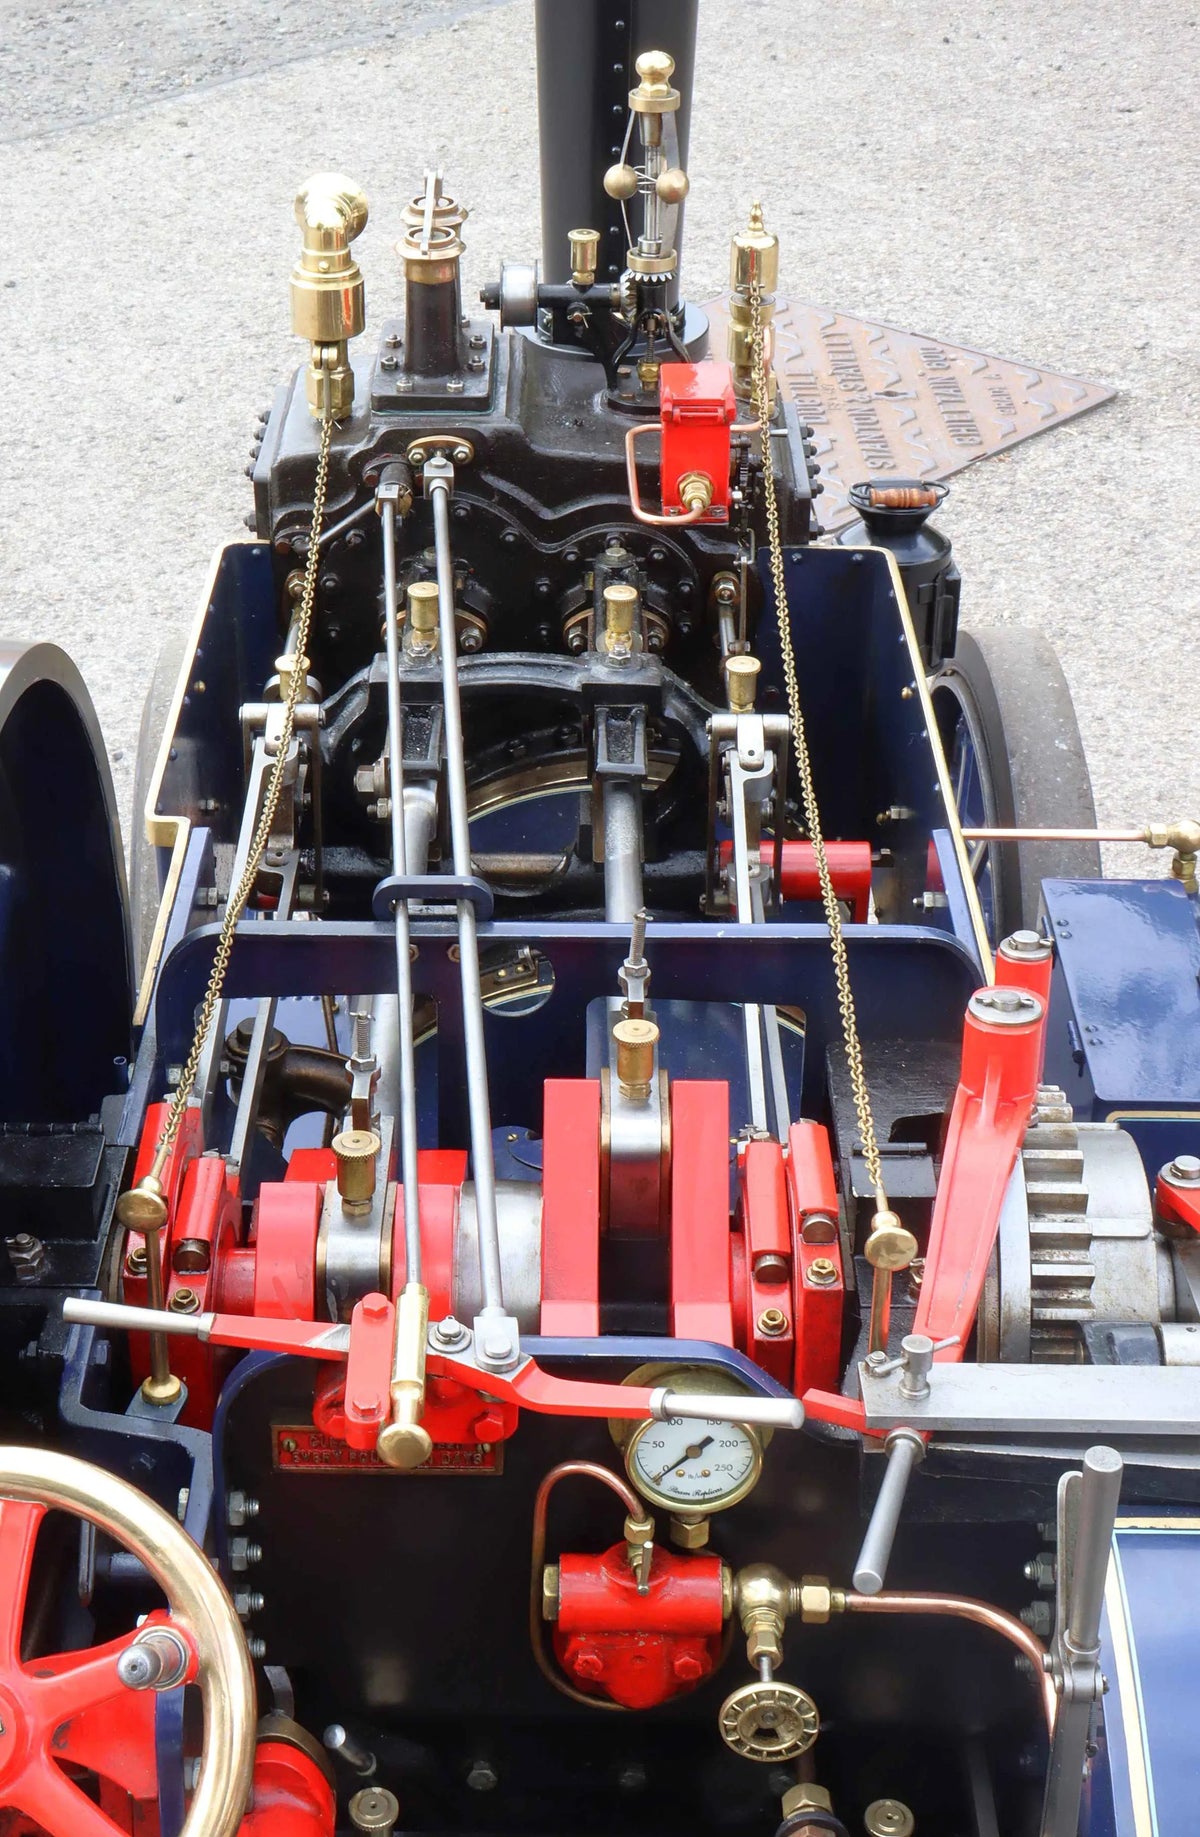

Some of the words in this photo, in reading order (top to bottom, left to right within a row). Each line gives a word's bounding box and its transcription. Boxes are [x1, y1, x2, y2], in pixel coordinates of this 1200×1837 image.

[822, 332, 867, 391] STAVELEY
[785, 367, 828, 424] DUCTILE
[846, 407, 896, 469] STANTON
[652, 1441, 665, 1449] 50
[719, 1440, 738, 1448] 200
[714, 1464, 733, 1472] 250
